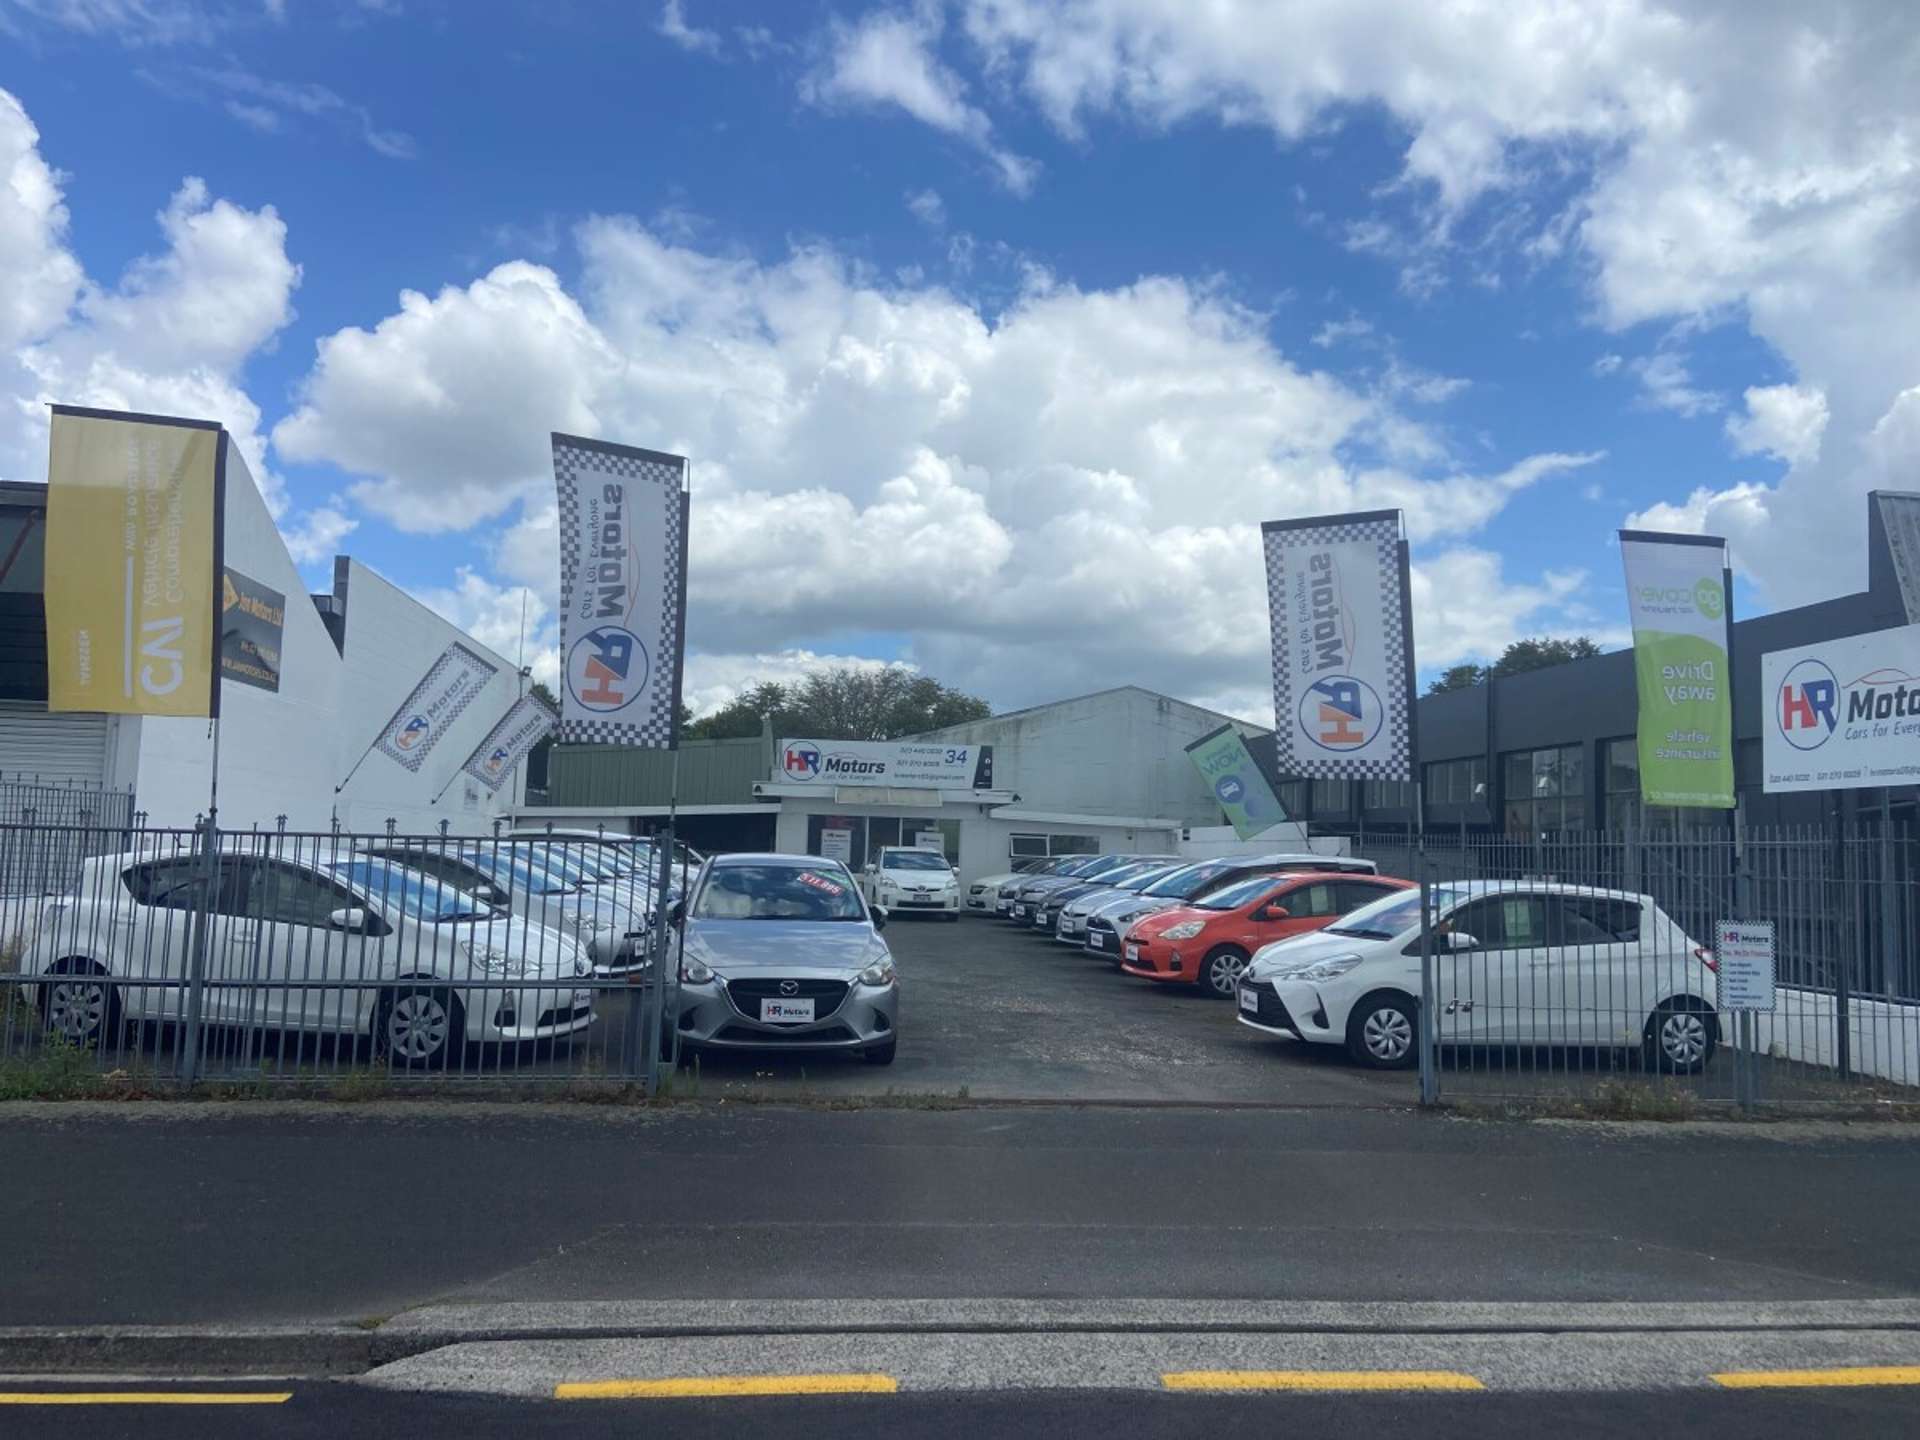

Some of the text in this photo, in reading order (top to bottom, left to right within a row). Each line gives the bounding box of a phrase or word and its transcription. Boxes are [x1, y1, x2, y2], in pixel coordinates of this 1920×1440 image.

[427, 669, 470, 718] Motors
[1783, 679, 1837, 735] HR
[1845, 727, 1868, 740] Cars
[1872, 723, 1888, 737] for
[785, 750, 885, 775] HR Motors
[944, 749, 968, 765] 34
[1723, 932, 1769, 943] HR Motors
[767, 1005, 811, 1017] HR Motors
